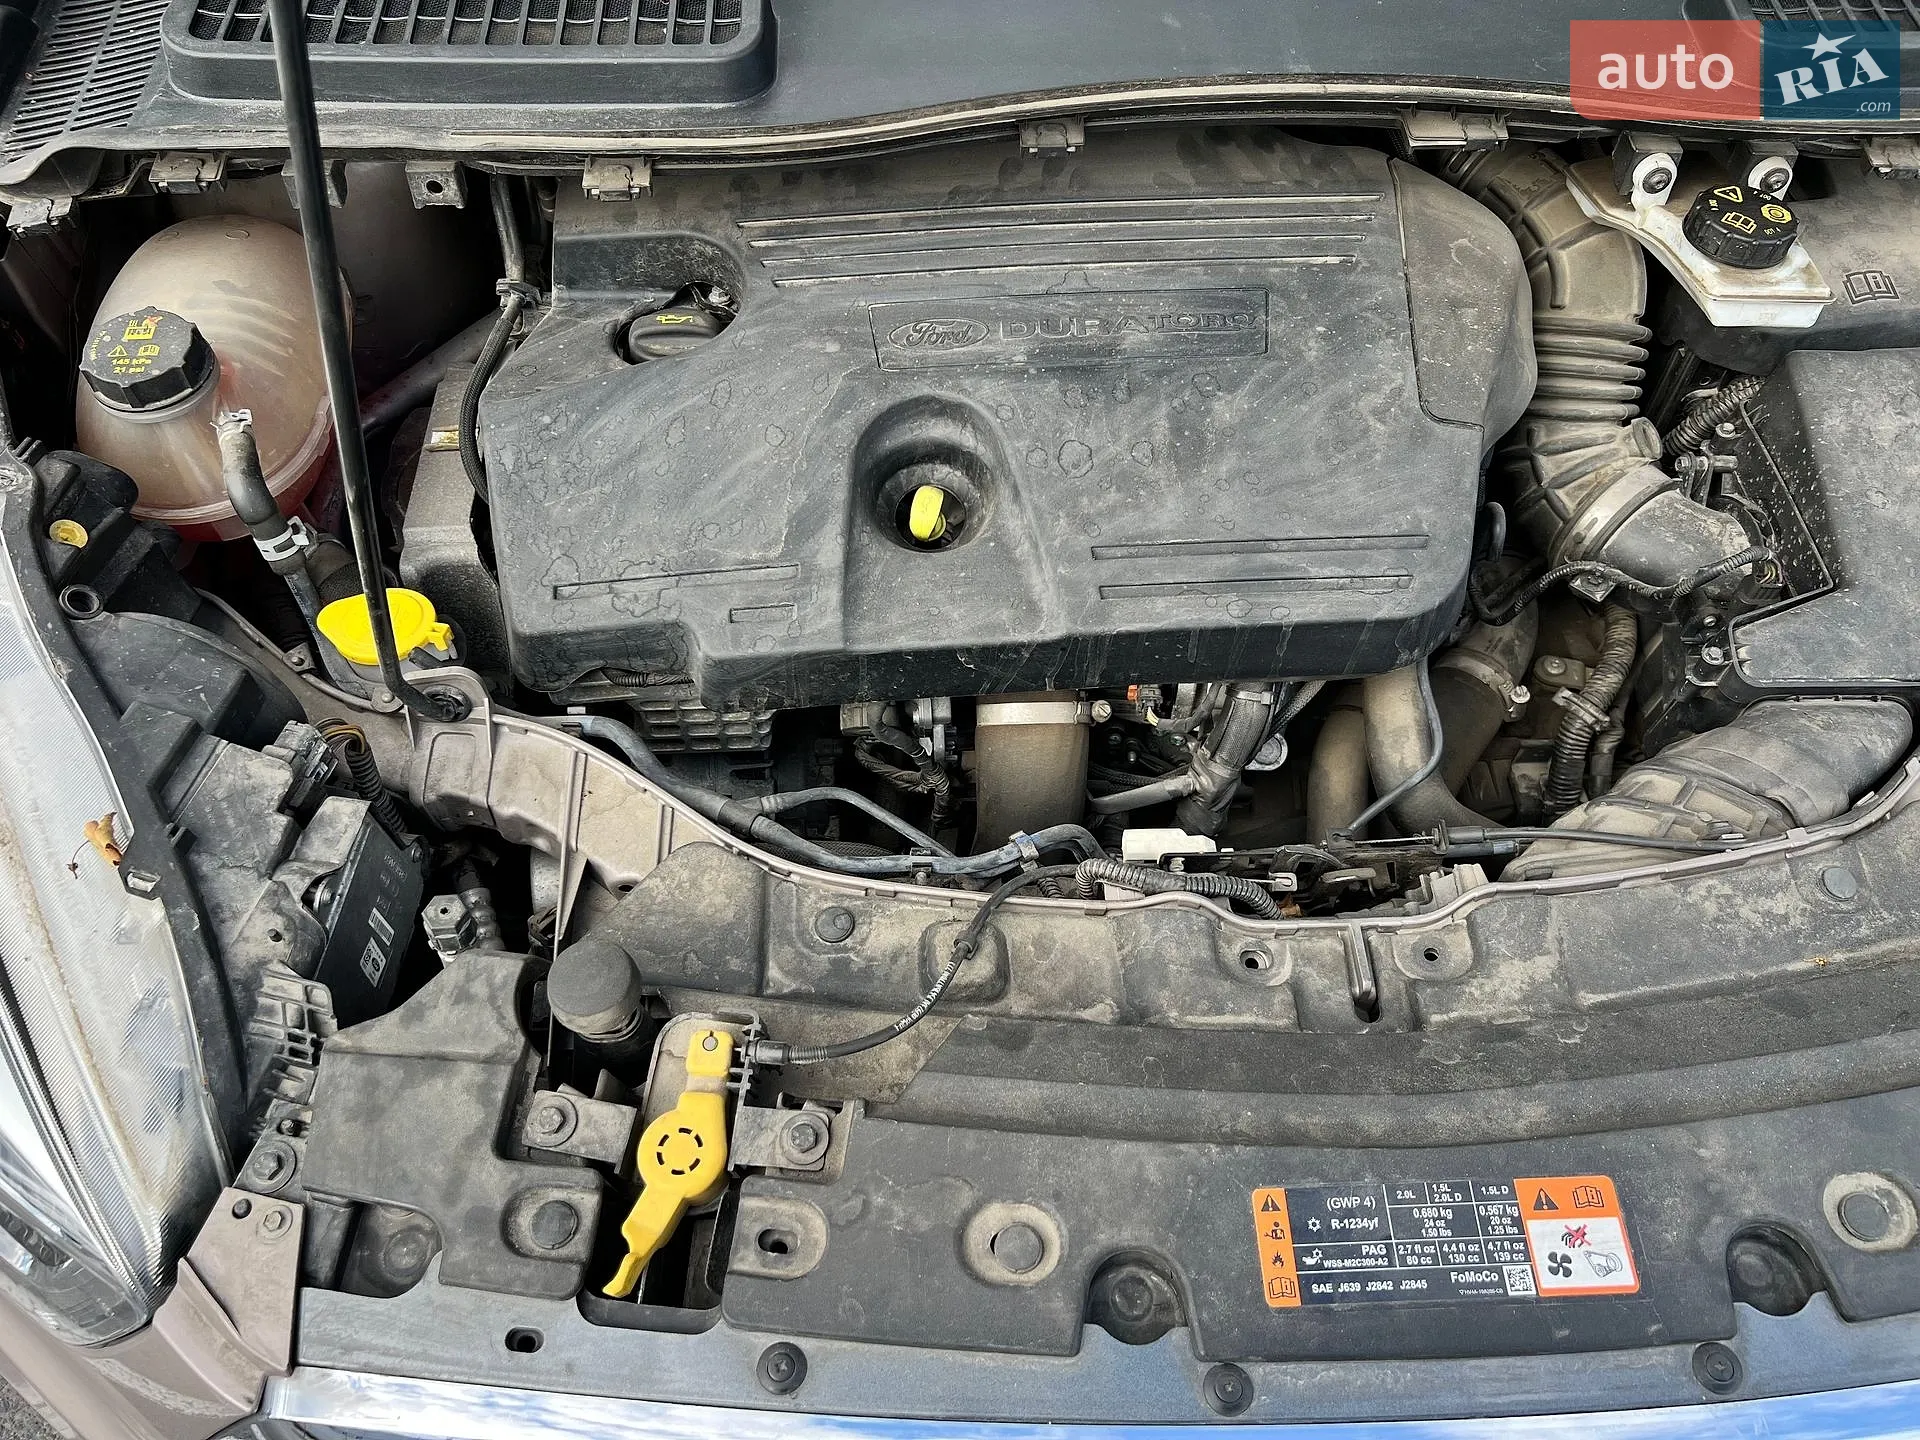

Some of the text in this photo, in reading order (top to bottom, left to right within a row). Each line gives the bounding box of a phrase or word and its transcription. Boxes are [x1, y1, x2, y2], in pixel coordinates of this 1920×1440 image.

[1000, 313, 1257, 340] DURATORQ
[905, 319, 973, 347] Ford
[111, 358, 131, 366] 145
[1431, 1183, 1452, 1193] 1.5L
[1480, 1185, 1509, 1195] 1.5L D
[1396, 1190, 1416, 1200] 2.0L
[1433, 1192, 1462, 1202] 2.0L D
[1326, 1195, 1376, 1211] (GWP 4)
[1412, 1207, 1453, 1220] 0.680 kg
[1478, 1203, 1519, 1217] 0.567 kg
[1330, 1216, 1379, 1230] R-1234yf
[1423, 1219, 1446, 1228] 24 oz
[1490, 1216, 1512, 1225] 20 oz
[1421, 1227, 1452, 1238] 1.50 lbs
[1487, 1225, 1518, 1235] 1.25 lbs
[1361, 1244, 1387, 1256] PAG
[1398, 1244, 1436, 1255] 2.7 fl oz
[1442, 1242, 1480, 1253] 4.4 fl oz
[1487, 1240, 1525, 1251] 4.7 fl oz
[1323, 1257, 1389, 1268] WSS-M2C300-A2
[1406, 1255, 1433, 1265] 80 cc
[1448, 1254, 1480, 1263] 130 cc
[1493, 1252, 1525, 1262] 139 cc
[1449, 1270, 1499, 1284] FoMoCo
[1311, 1279, 1428, 1294] SAE J639 J2842 J2845
